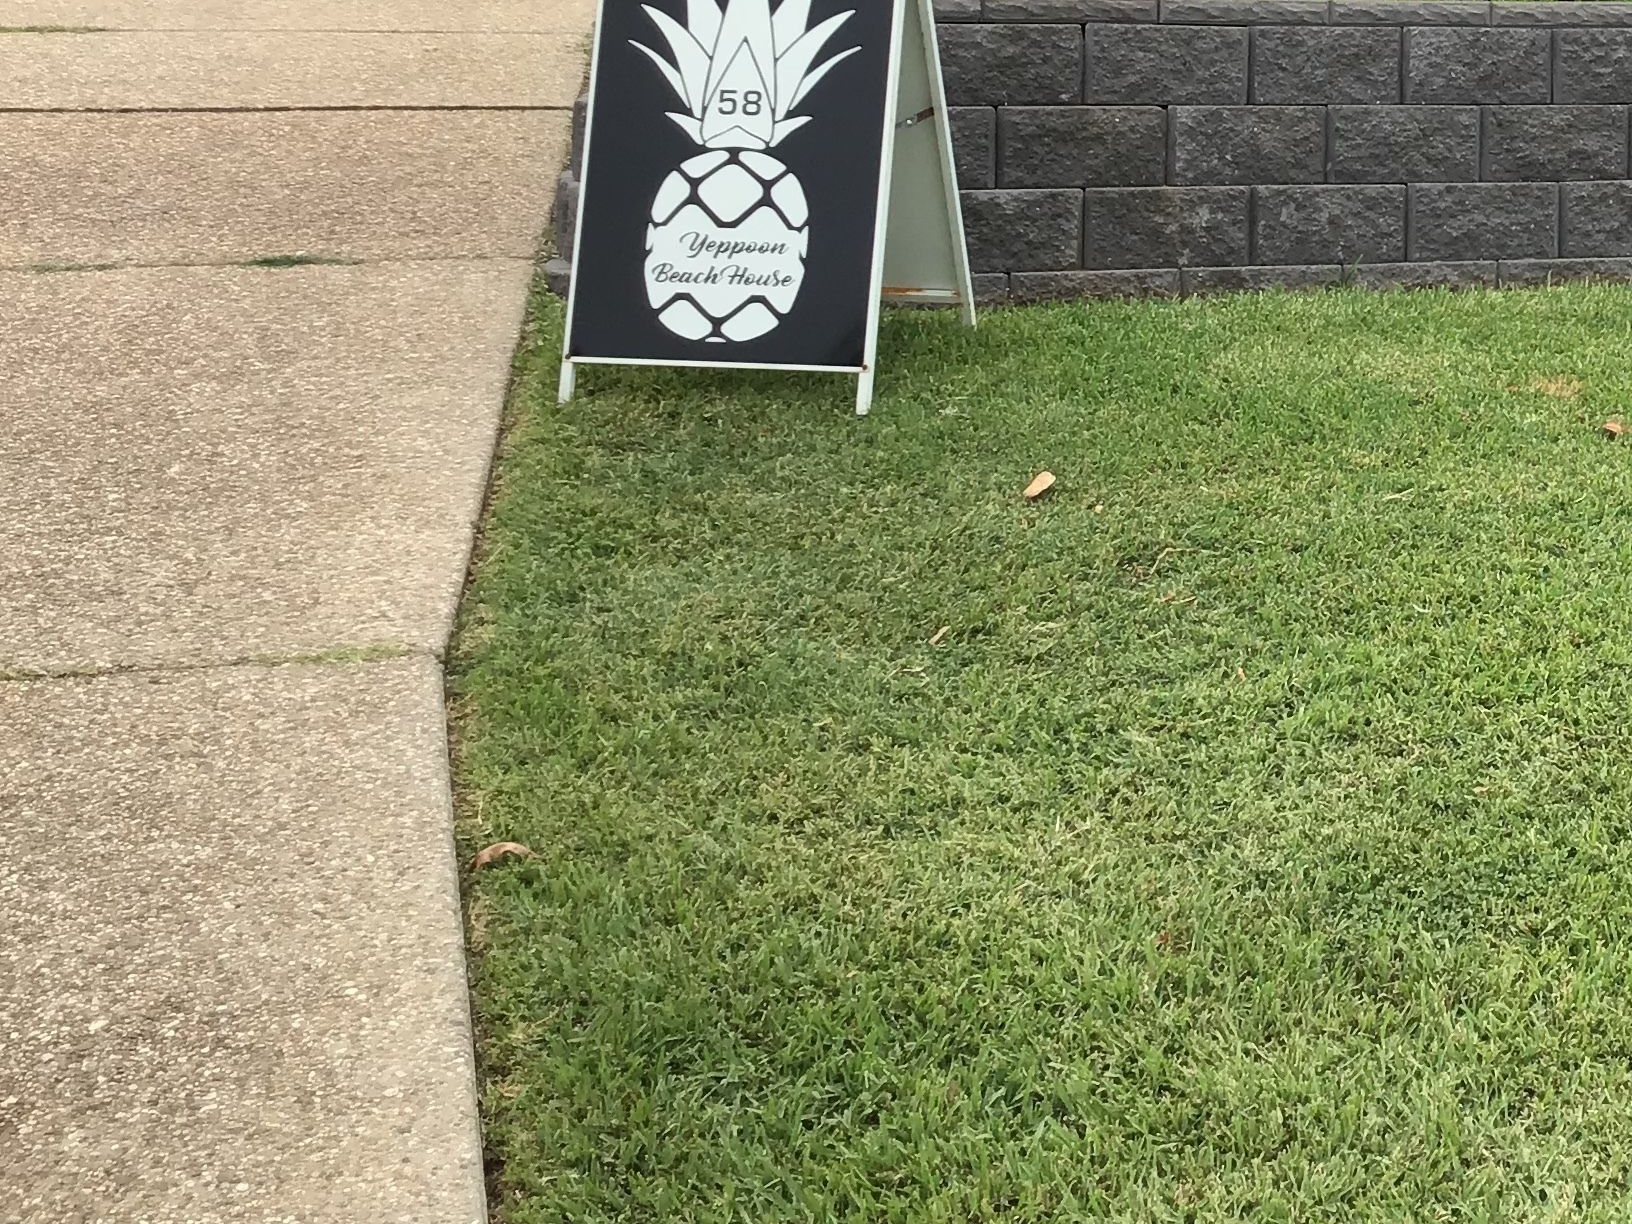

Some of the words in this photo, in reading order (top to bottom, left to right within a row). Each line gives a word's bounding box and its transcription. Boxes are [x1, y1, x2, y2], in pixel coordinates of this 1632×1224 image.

[717, 89, 762, 117] 58
[679, 231, 789, 260] Yeppoon
[651, 262, 720, 285] Beach
[720, 264, 796, 288] House
